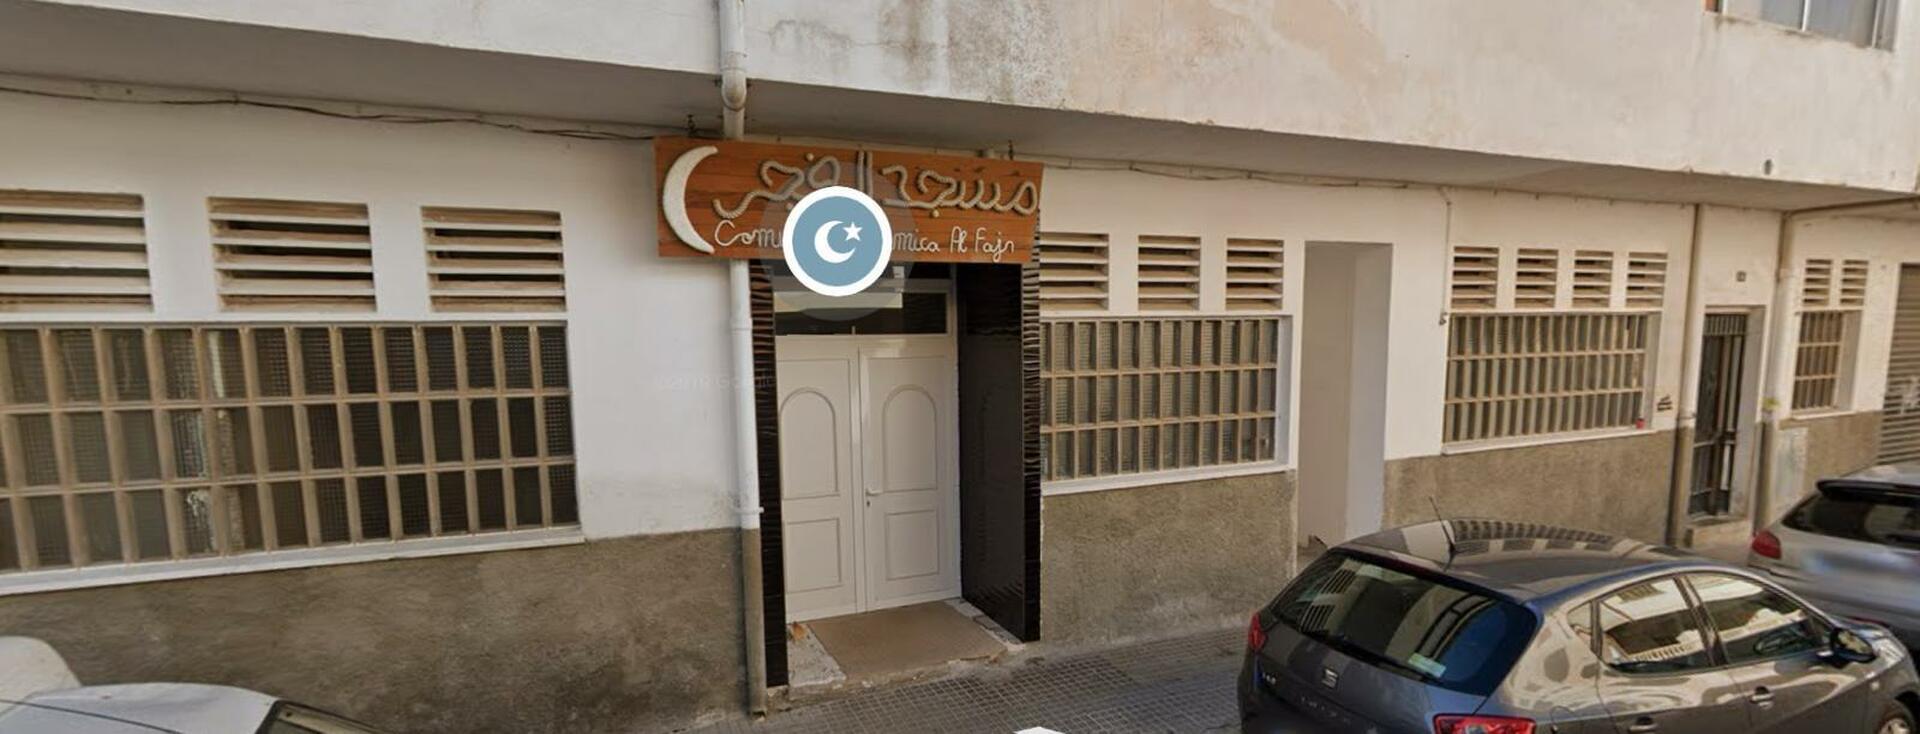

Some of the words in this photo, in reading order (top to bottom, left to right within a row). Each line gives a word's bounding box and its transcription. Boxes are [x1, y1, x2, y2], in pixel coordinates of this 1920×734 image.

[892, 228, 941, 252] mica
[949, 225, 968, 253] Al
[974, 226, 1015, 263] Fajr
